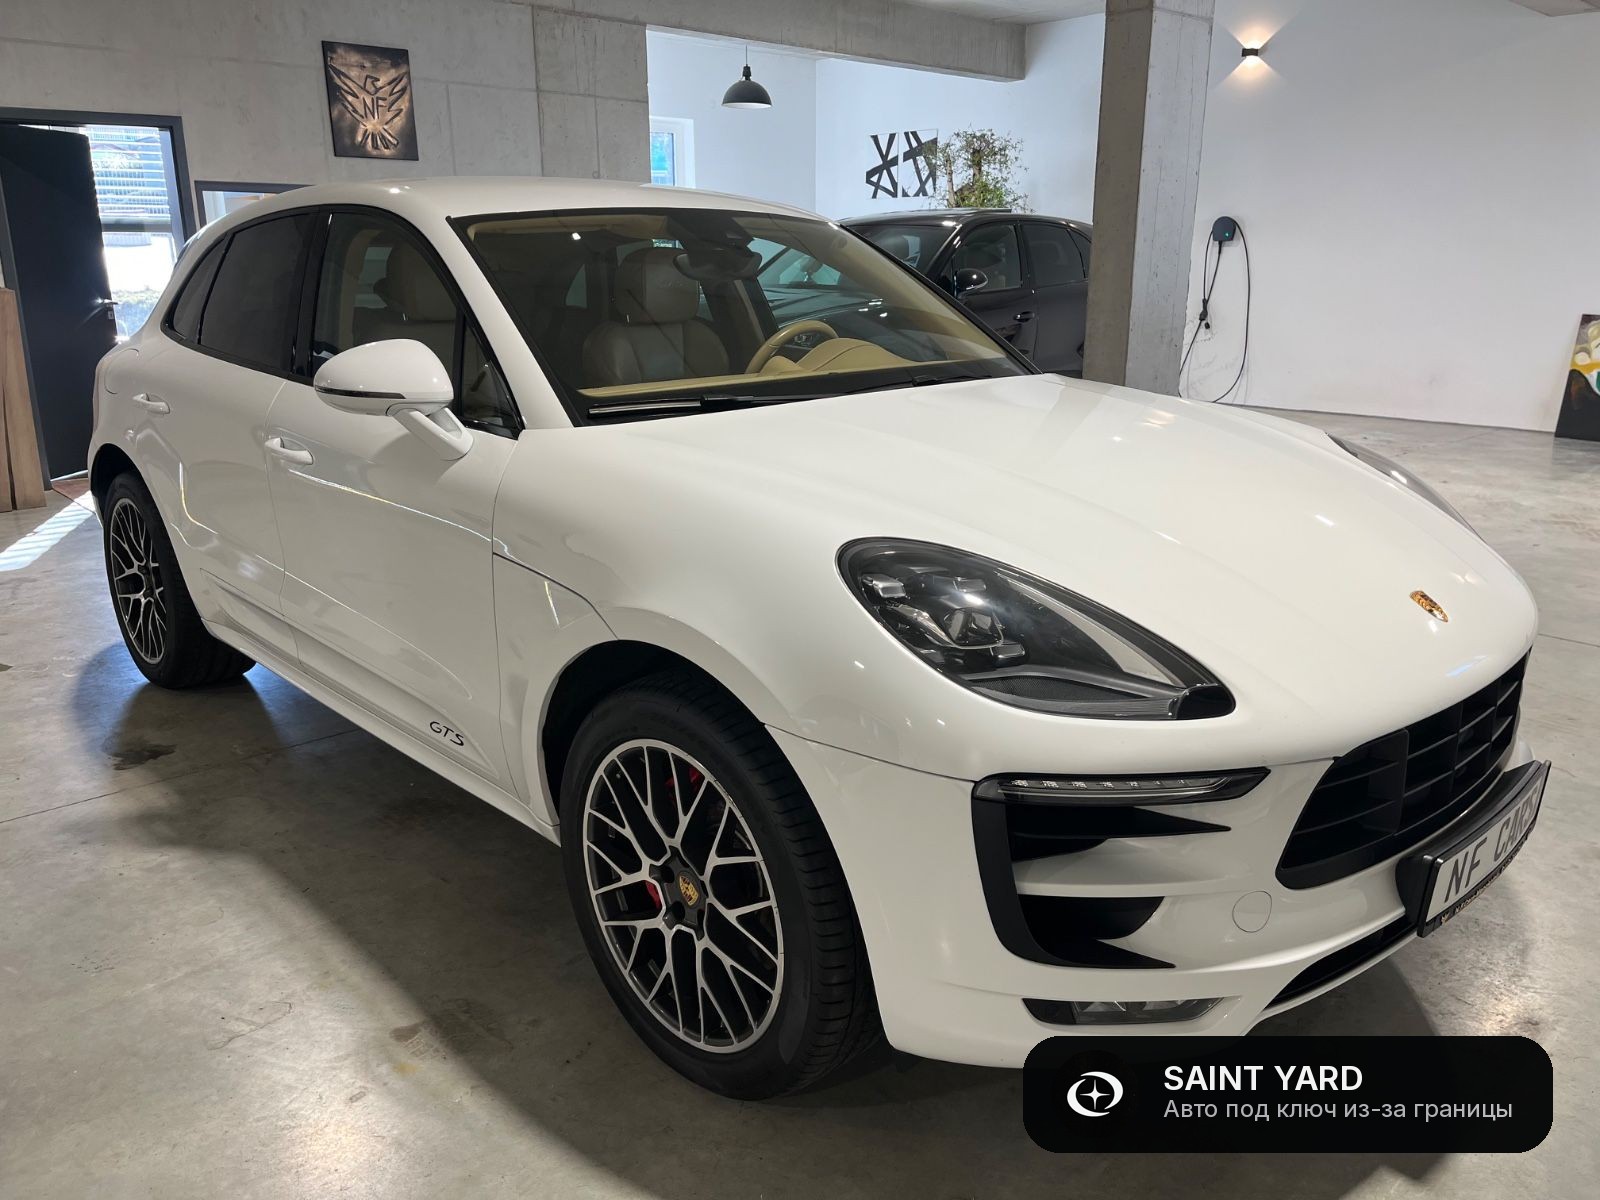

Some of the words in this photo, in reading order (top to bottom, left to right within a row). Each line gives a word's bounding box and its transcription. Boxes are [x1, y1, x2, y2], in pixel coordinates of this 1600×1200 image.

[363, 96, 387, 120] NF
[430, 721, 464, 746] GTS
[1444, 837, 1488, 903] NF
[1494, 784, 1539, 862] CARS
